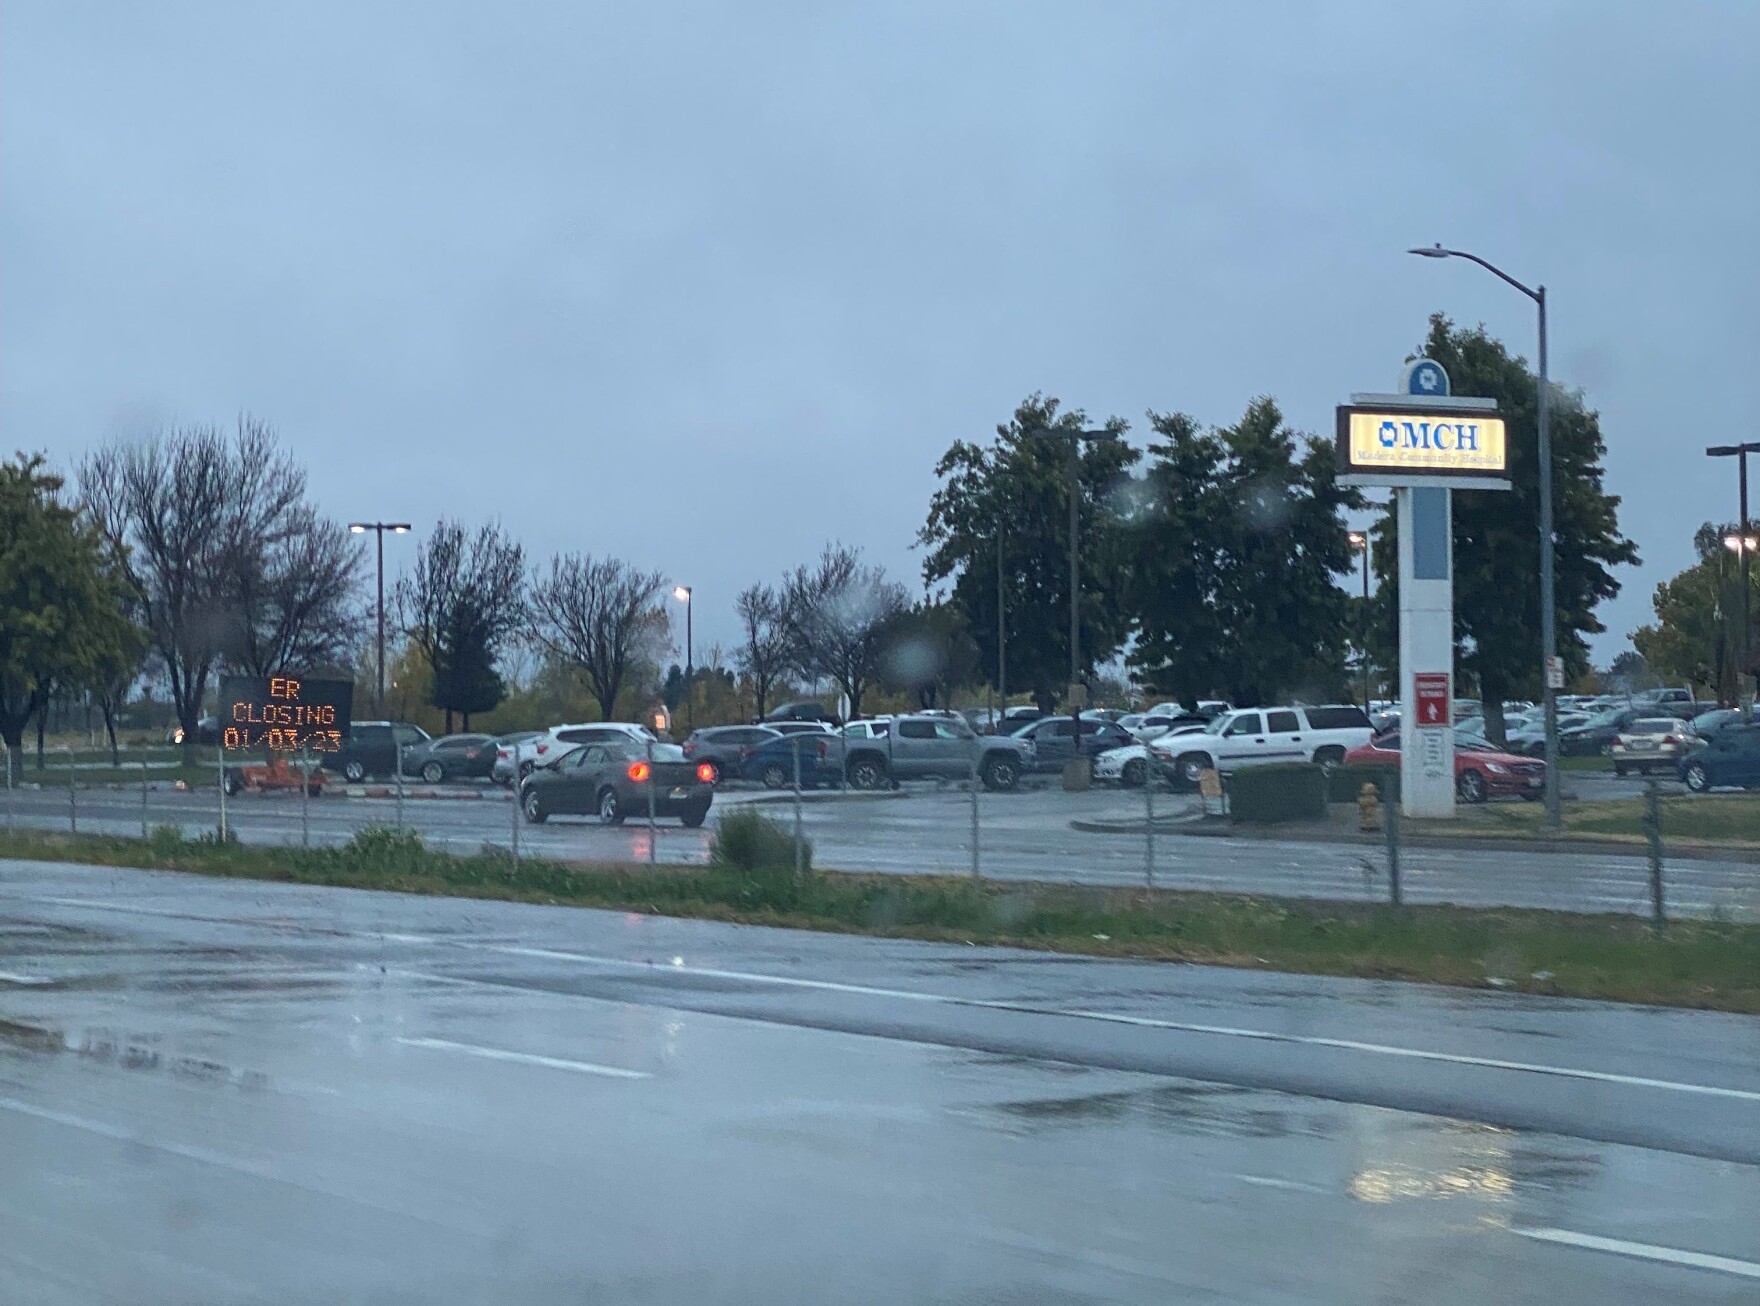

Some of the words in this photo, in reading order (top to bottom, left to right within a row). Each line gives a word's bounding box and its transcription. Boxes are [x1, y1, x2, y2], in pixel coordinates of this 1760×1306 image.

[1401, 422, 1479, 451] MCH
[1399, 452, 1457, 464] Community
[270, 677, 301, 700] ER
[232, 701, 336, 726] CLOSING
[224, 727, 342, 753] 01/03/23
